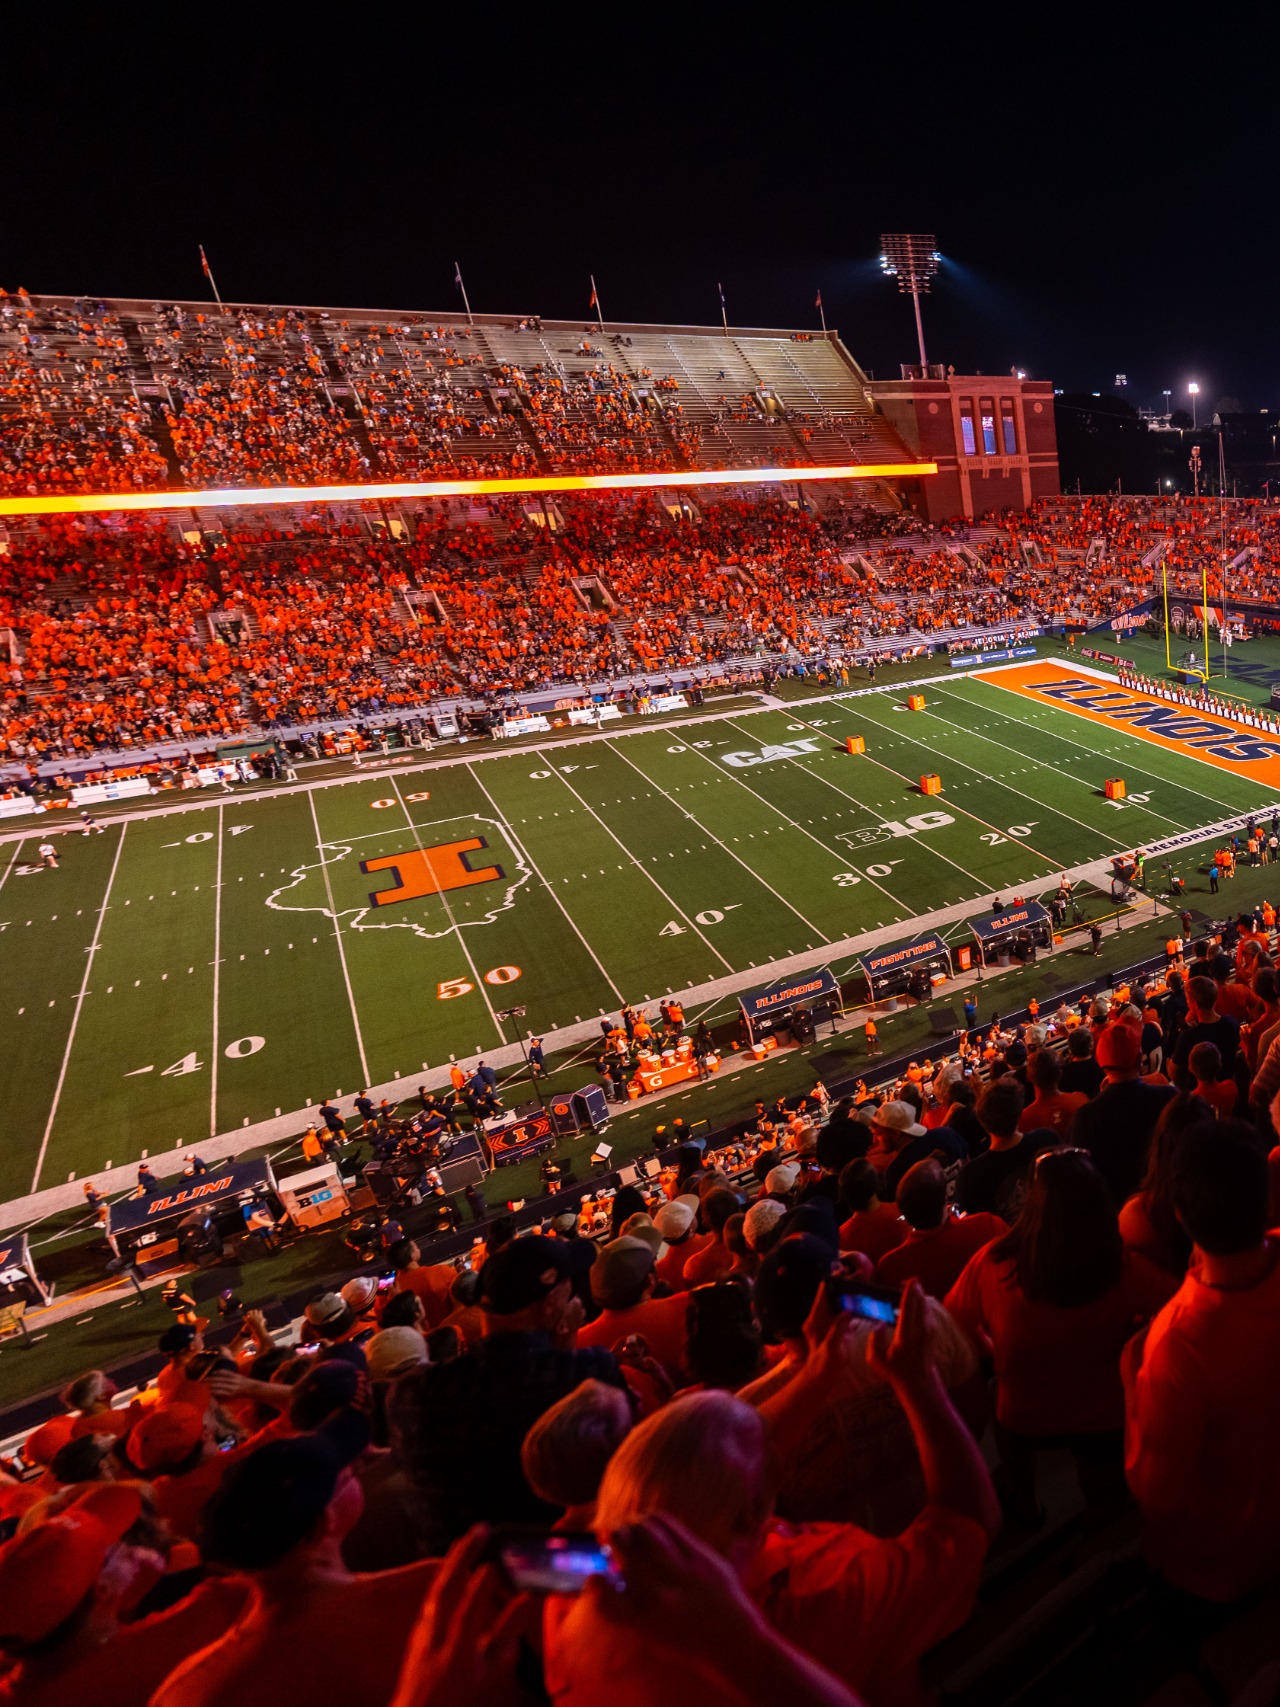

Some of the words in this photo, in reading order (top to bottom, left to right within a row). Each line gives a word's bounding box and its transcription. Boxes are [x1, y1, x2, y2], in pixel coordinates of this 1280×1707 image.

[721, 736, 821, 768] CAT
[1101, 792, 1150, 811] 10
[979, 824, 1033, 848] 20
[1146, 827, 1224, 854] MEMORIAL
[832, 863, 893, 888] 30
[658, 909, 726, 938] 40
[990, 910, 1029, 930] ILLINI
[869, 939, 938, 971] FIGHTING
[436, 965, 523, 1001] 50
[755, 978, 823, 1010] ILLINOIS
[160, 1035, 266, 1078] 40
[649, 1074, 663, 1087] G
[147, 1175, 235, 1216] ILLINI
